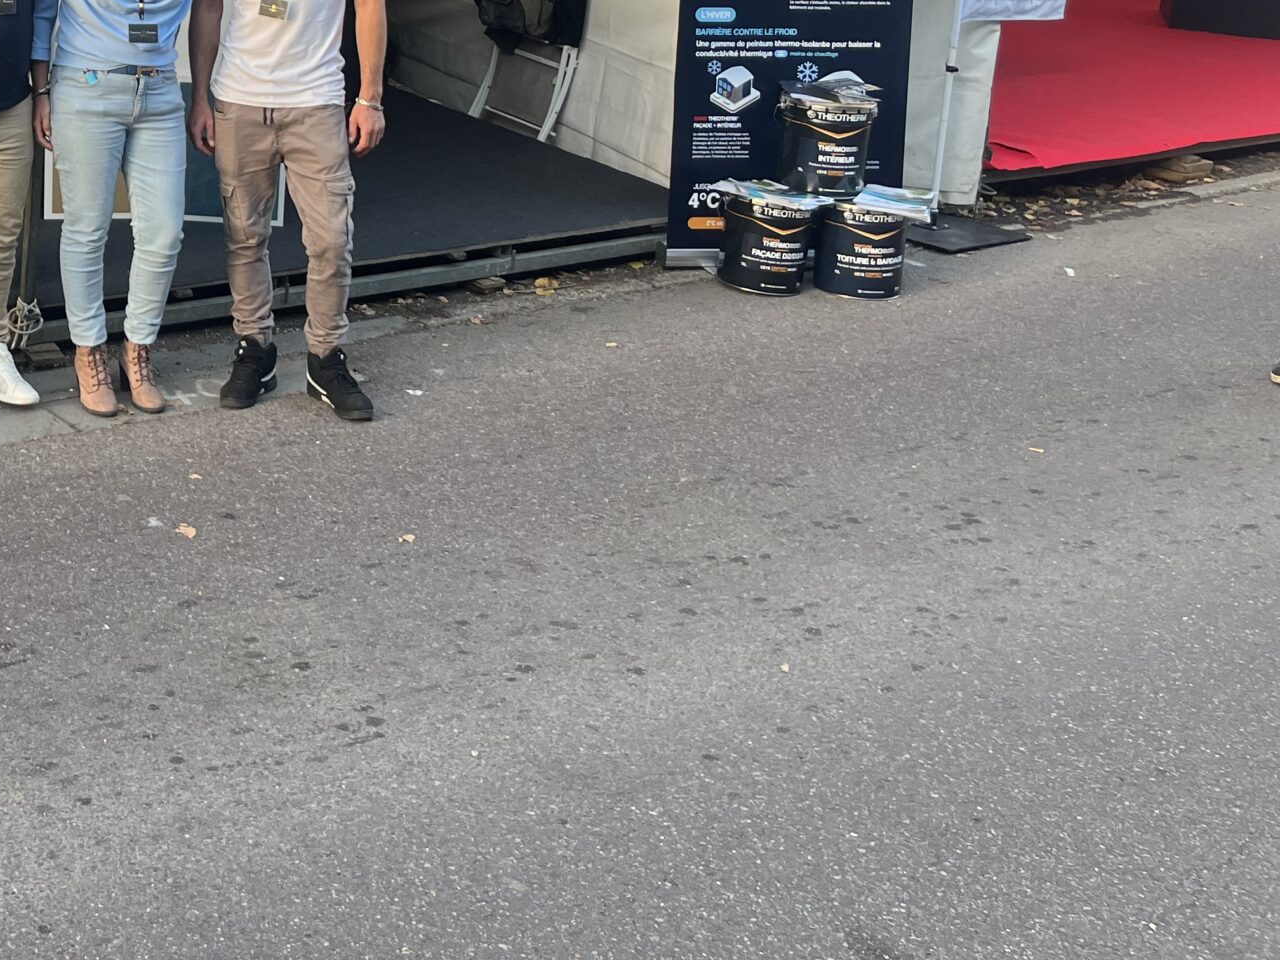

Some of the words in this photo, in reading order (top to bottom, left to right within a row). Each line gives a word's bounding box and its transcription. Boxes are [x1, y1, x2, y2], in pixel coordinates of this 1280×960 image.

[701, 11, 731, 19] L'HIVER
[695, 26, 733, 36] BARRIÈRE
[733, 28, 764, 36] CONTRE
[764, 28, 774, 36] LE
[774, 28, 798, 36] FROID
[709, 41, 735, 49] gamme
[746, 40, 774, 49] peinture
[831, 41, 847, 49] pour
[695, 49, 739, 58] conductivité
[739, 49, 773, 59] thermique
[751, 247, 782, 259] FAÇADE
[836, 253, 870, 265] TOITURE
